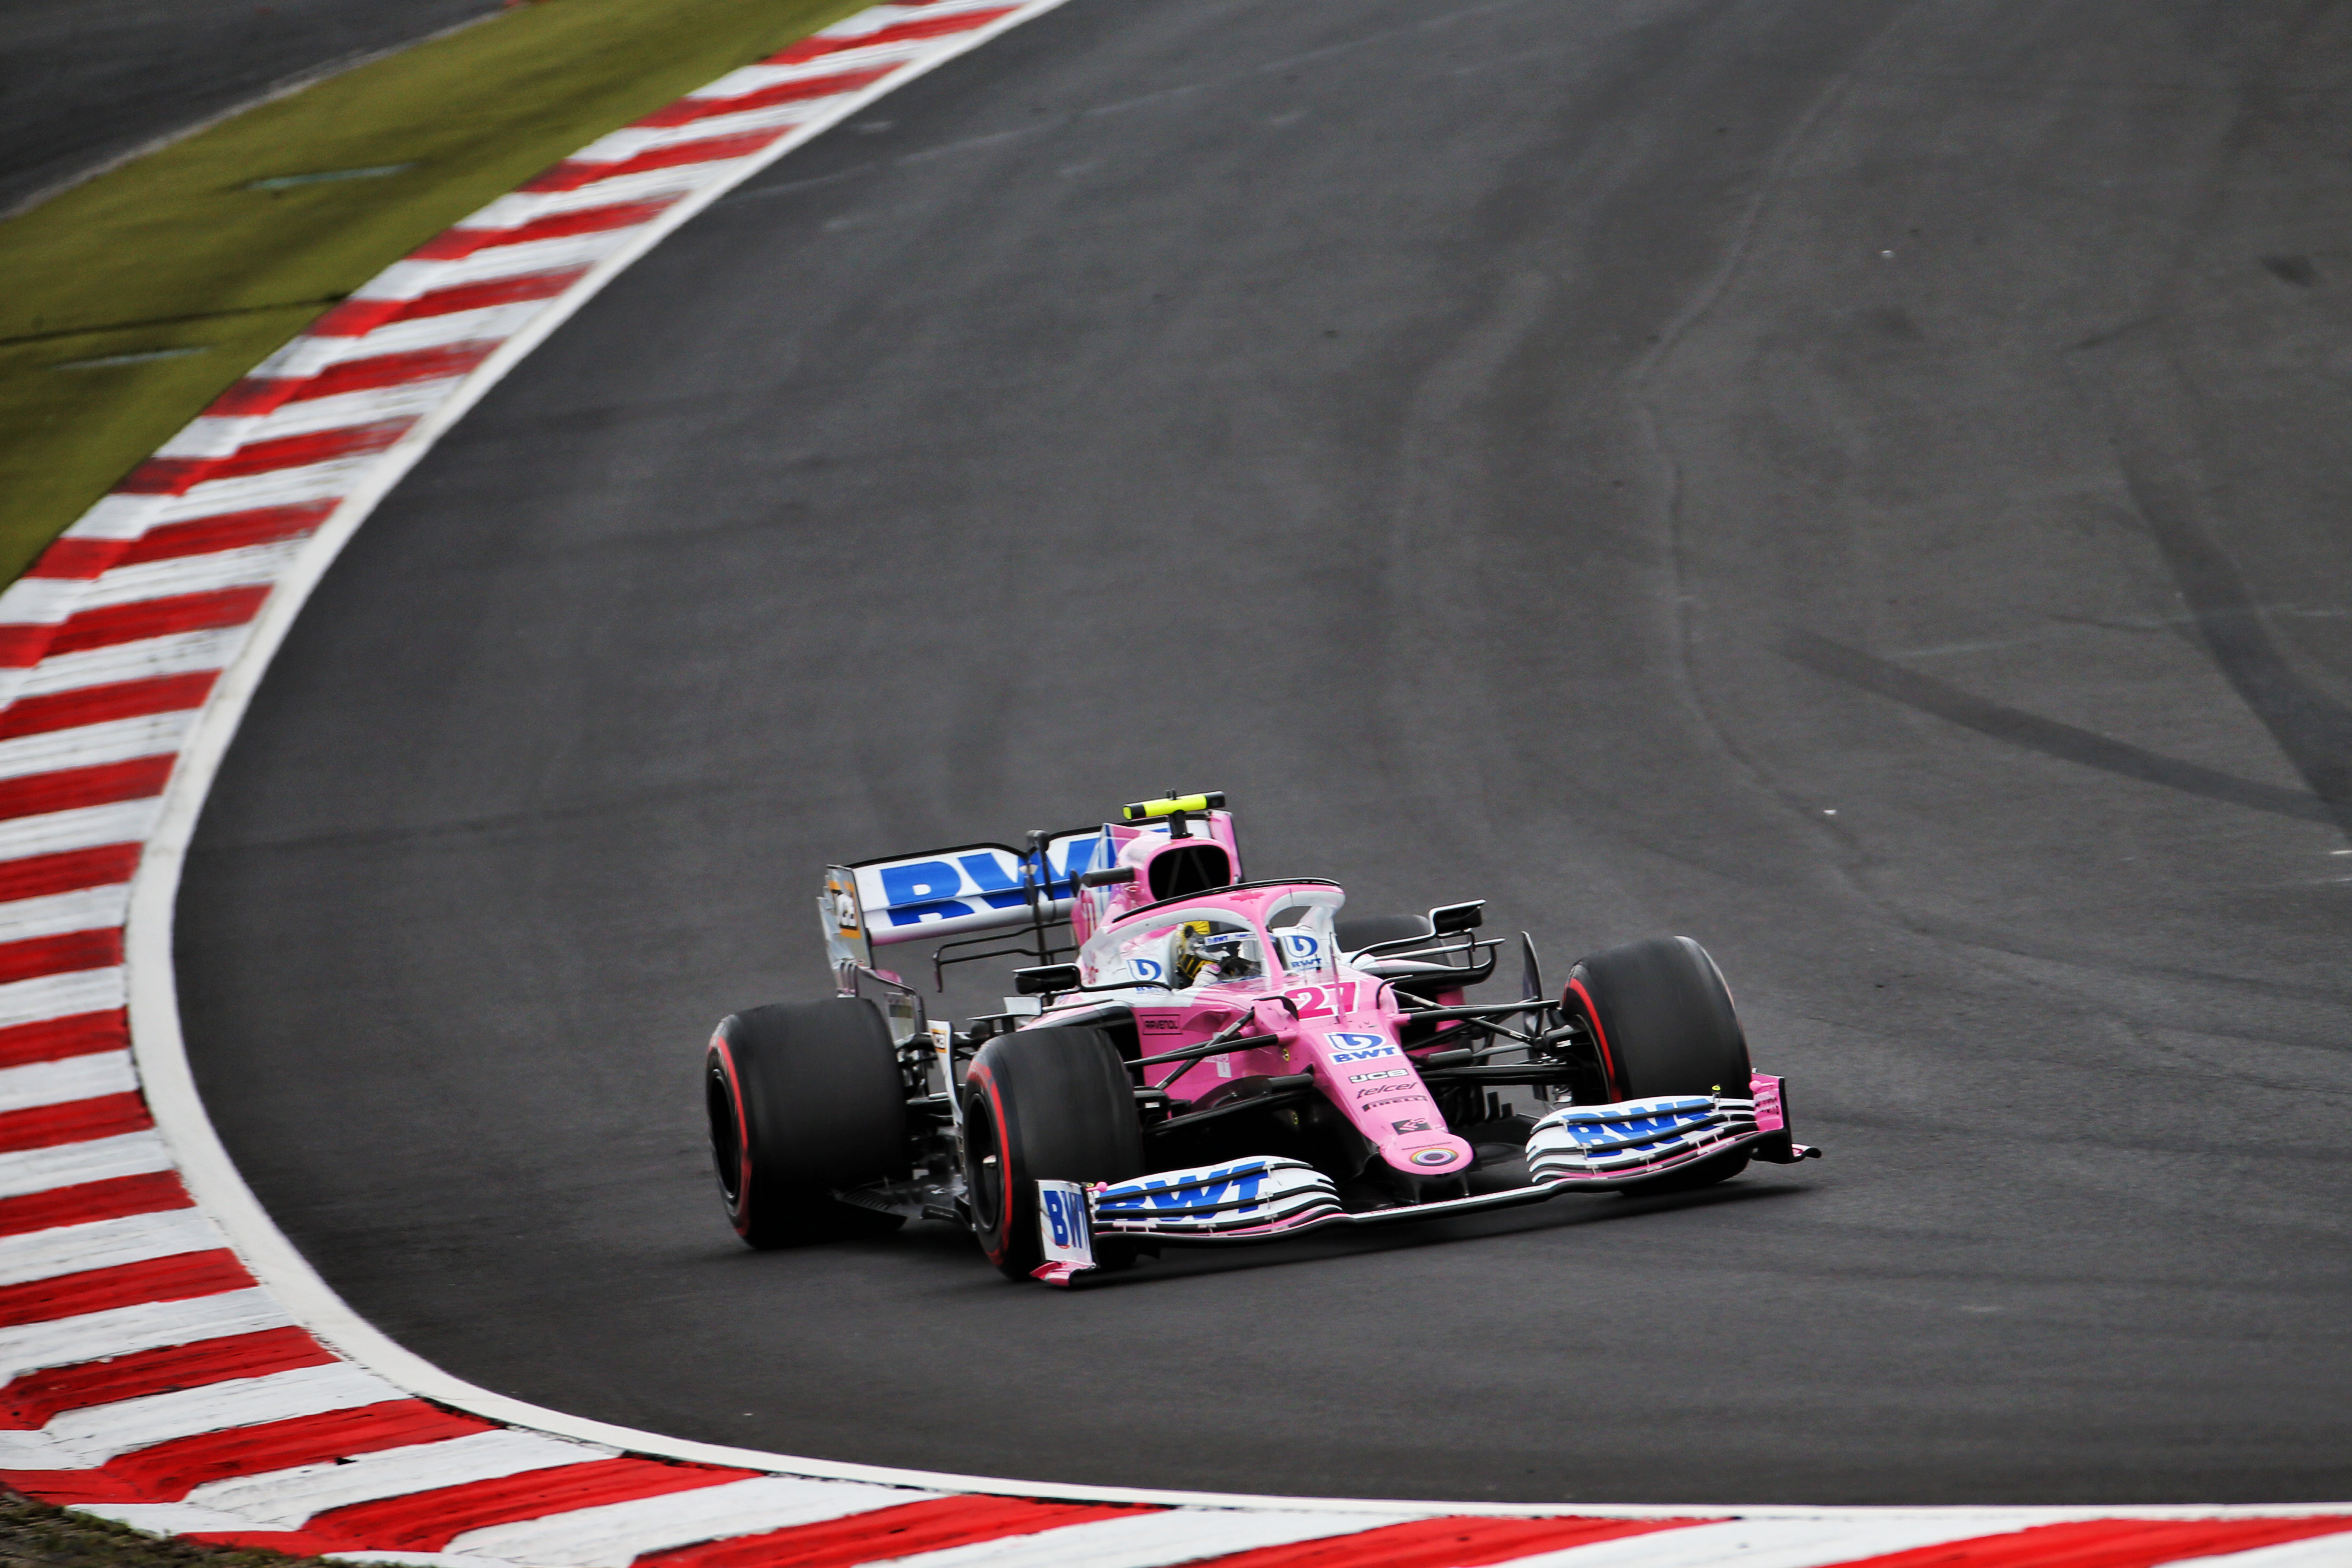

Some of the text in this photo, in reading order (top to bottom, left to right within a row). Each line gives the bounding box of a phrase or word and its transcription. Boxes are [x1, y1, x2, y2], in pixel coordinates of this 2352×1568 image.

[881, 828, 1169, 926] BW
[1291, 957, 1323, 968] BWT
[1284, 981, 1357, 1019] 27
[1333, 1046, 1395, 1063] BWT
[1348, 1068, 1410, 1083] JCB
[1356, 1082, 1418, 1099] telcel
[1362, 1095, 1429, 1112] PIRELLI
[1561, 1098, 1720, 1158] BWT
[1096, 1161, 1269, 1222] BWT
